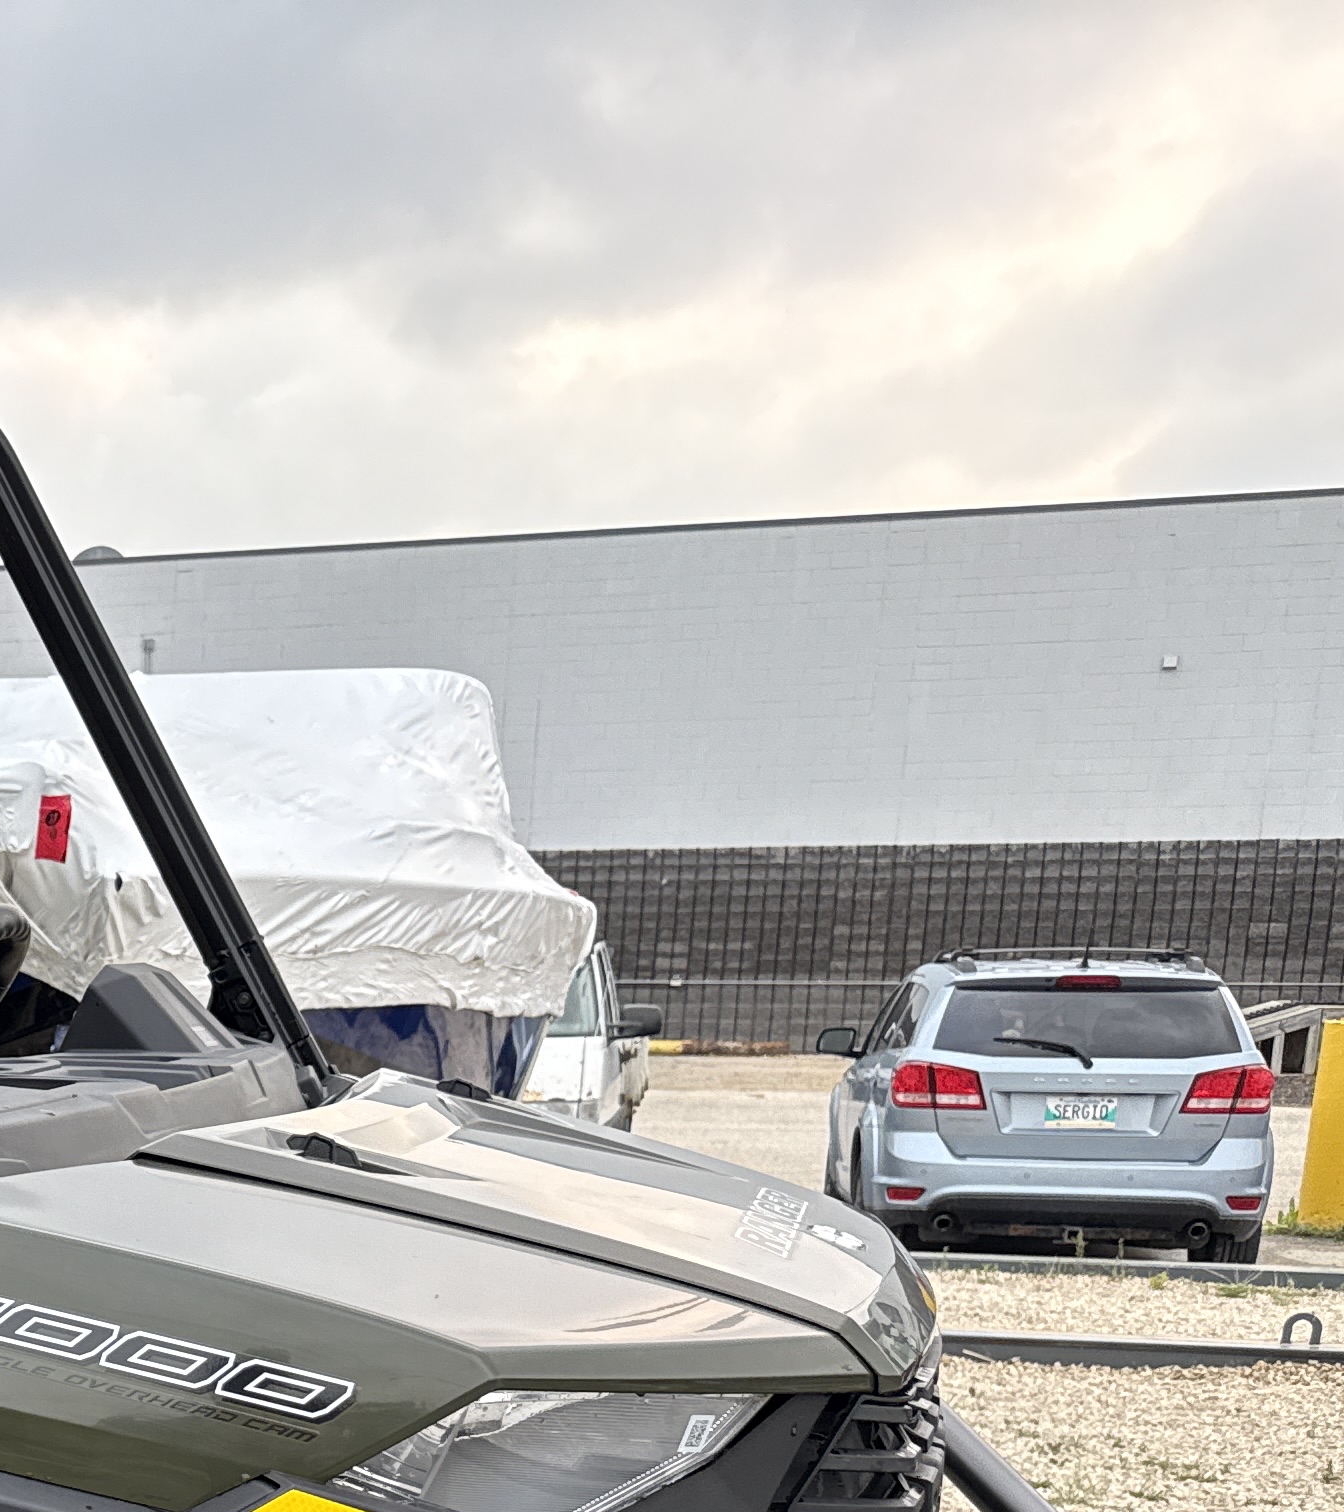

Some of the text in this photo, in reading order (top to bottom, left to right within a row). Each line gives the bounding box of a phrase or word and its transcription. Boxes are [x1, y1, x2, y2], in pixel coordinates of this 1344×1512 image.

[1052, 1103, 1109, 1120] SERGIO
[734, 1187, 809, 1259] RANGER
[67, 1373, 237, 1423] OVERHEAD
[241, 1417, 321, 1443] CAM
